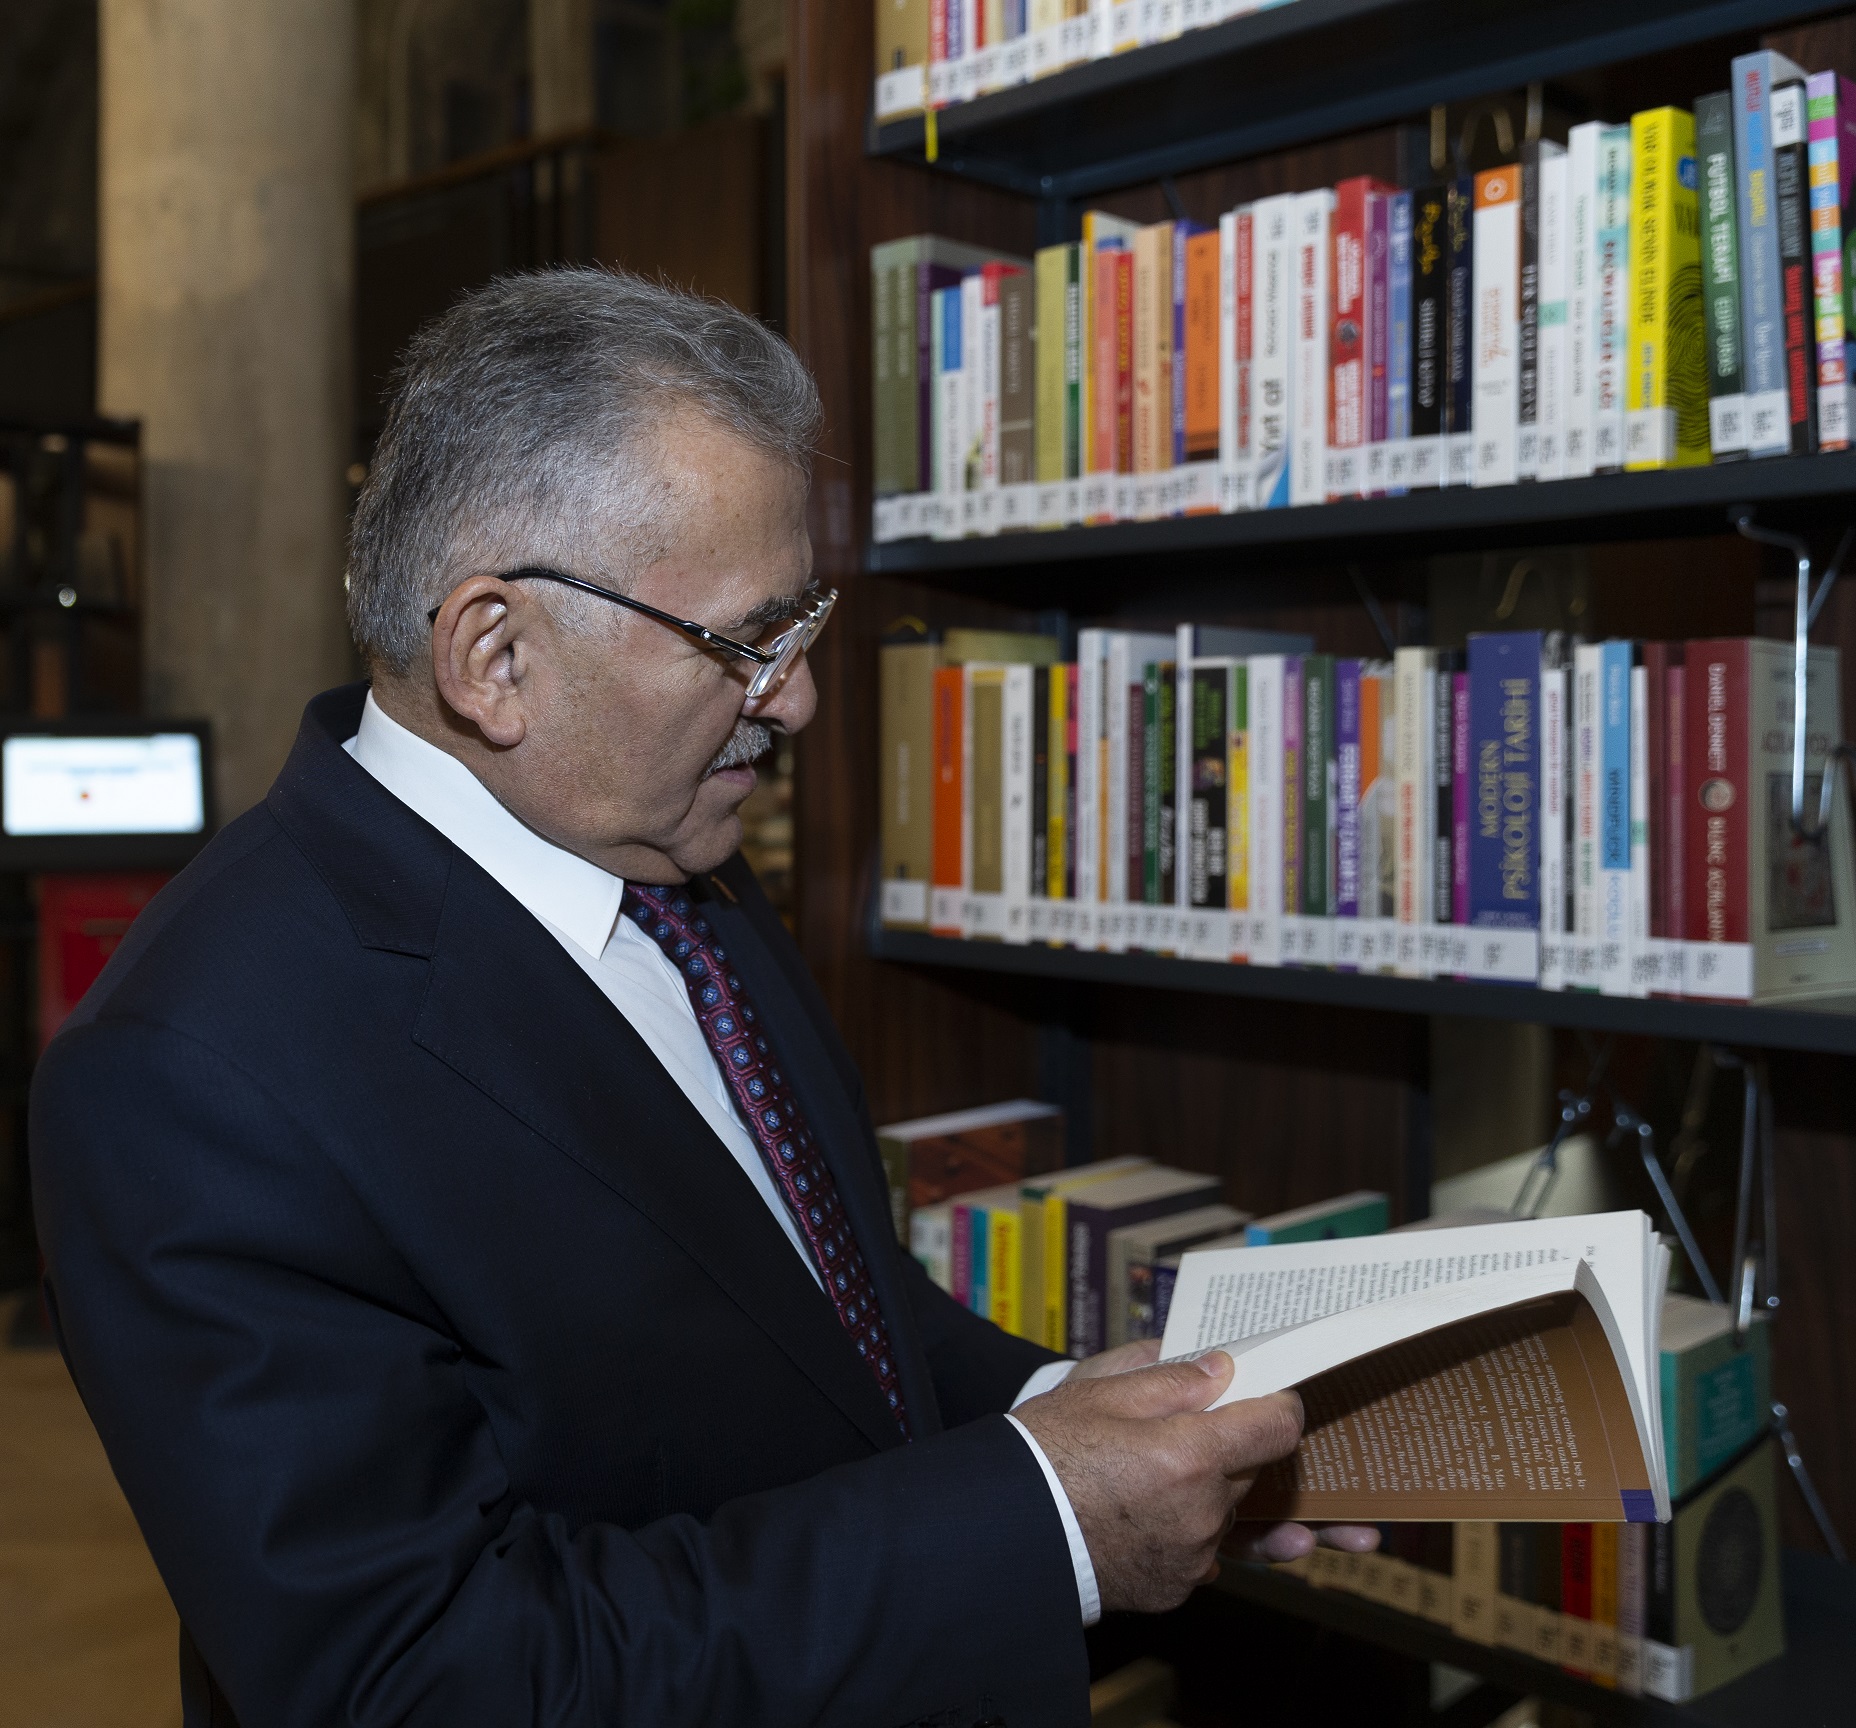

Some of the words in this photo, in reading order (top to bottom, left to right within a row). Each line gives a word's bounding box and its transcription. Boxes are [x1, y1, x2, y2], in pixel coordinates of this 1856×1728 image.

[1706, 152, 1730, 222] FUTBOL
[1711, 222, 1736, 284] TERAPİ
[1815, 256, 1841, 317] hayal
[1707, 662, 1727, 713] DANIEL
[1501, 677, 1532, 765] TARİHİ
[1707, 713, 1727, 772] DENNETT
[1478, 739, 1500, 839] MODERN
[1501, 771, 1532, 900] PSİKOLOJİ
[1532, 1365, 1541, 1373] on
[1543, 1364, 1564, 1402] antropolog
[1499, 1378, 1516, 1405] birikimi
[1536, 1375, 1553, 1404] binlerce
[1404, 1400, 1412, 1408] ve
[1430, 1409, 1442, 1424] ilkel
[1477, 1405, 1488, 1415] M.
[1509, 1408, 1520, 1418] bu
[1521, 1373, 1542, 1411] çalışmaları
[1536, 1414, 1551, 1441] Lucien
[1557, 1405, 1566, 1414] ve
[1364, 1421, 1377, 1438] nasıl
[1399, 1423, 1408, 1431] en
[1407, 1411, 1419, 1426] ilkel
[1484, 1374, 1505, 1413] dünyasının
[1499, 1416, 1518, 1457] temellerini
[1510, 1460, 1522, 1479] atar.
[1509, 1373, 1530, 1411] kaynağıdır.
[1537, 1467, 1550, 1489] kendi
[1547, 1407, 1564, 1443] kilometre
[1351, 1417, 1369, 1453] arasından
[1373, 1413, 1392, 1454] kavramının
[1402, 1434, 1417, 1461] önemli
[1419, 1415, 1442, 1470] görülmektedir.
[1433, 1426, 1453, 1464] toplumun
[1445, 1419, 1461, 1449] bilimsel
[1451, 1399, 1472, 1445] bakıldığında
[1465, 1450, 1483, 1490] insanlığın
[1481, 1421, 1497, 1448] Mauss,
[1513, 1421, 1528, 1448] kitapta
[1560, 1416, 1579, 1457] etnologun
[1318, 1438, 1332, 1461] sosyal
[1384, 1410, 1396, 1426] olan
[1402, 1480, 1412, 1490] bu
[1385, 1457, 1395, 1469] var
[1411, 1430, 1433, 1476] toplumların
[1490, 1454, 1500, 1462] B.
[1520, 1452, 1532, 1464] bir
[1556, 1446, 1571, 1473] uzakta
[1387, 1472, 1399, 1490] olup
[1480, 1474, 1495, 1490] gibi
[1523, 1467, 1536, 1489] araya
[1573, 1461, 1584, 1475] beş
[1561, 1477, 1573, 1489] ya-
